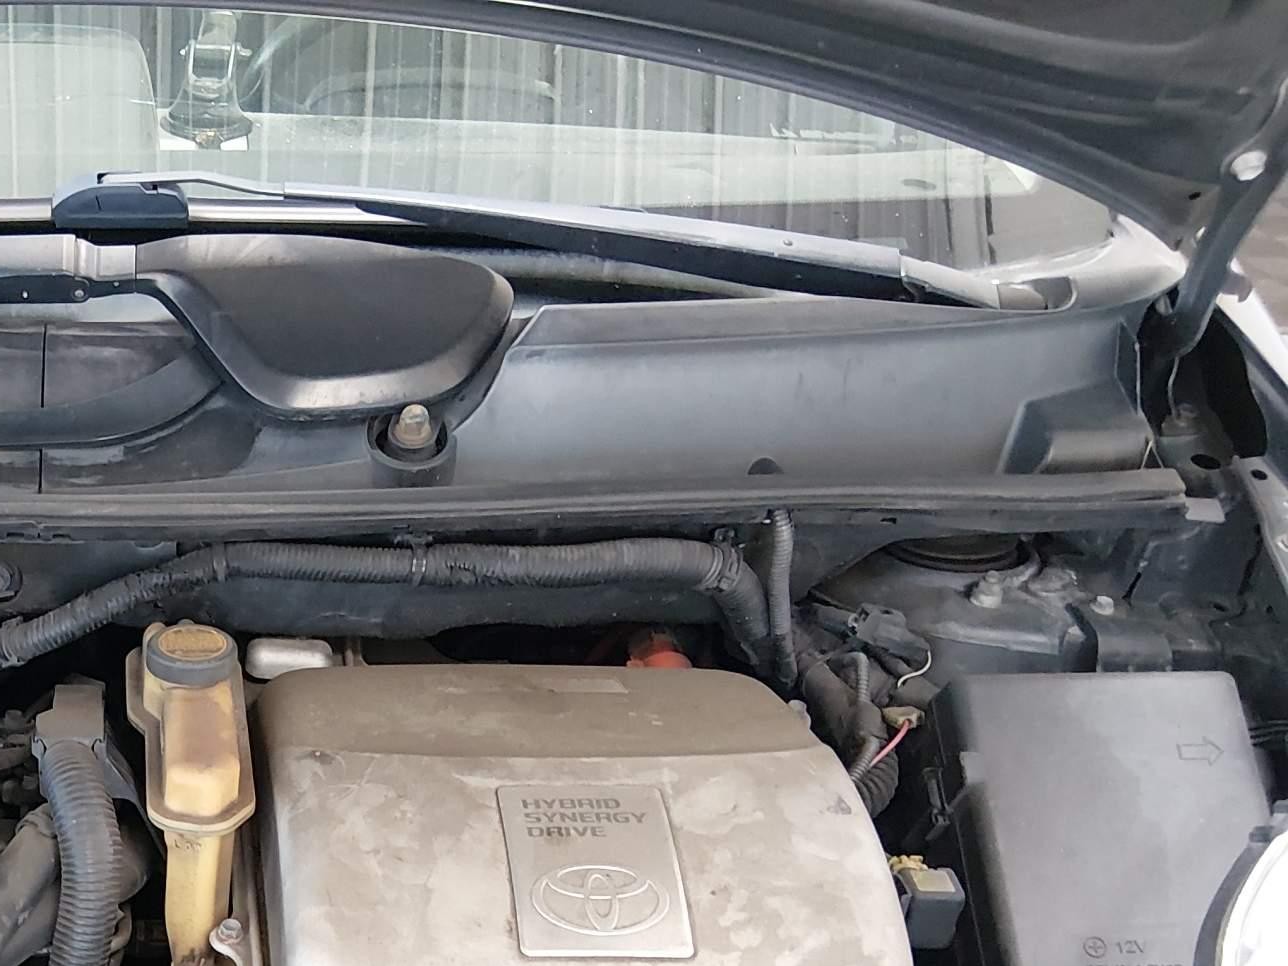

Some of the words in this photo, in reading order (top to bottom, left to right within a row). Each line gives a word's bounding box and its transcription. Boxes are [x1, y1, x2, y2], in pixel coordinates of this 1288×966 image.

[520, 797, 621, 811] HYBRID
[522, 811, 647, 825] SYNERGY
[527, 825, 607, 838] DRIVE
[1114, 940, 1147, 955] 12V
